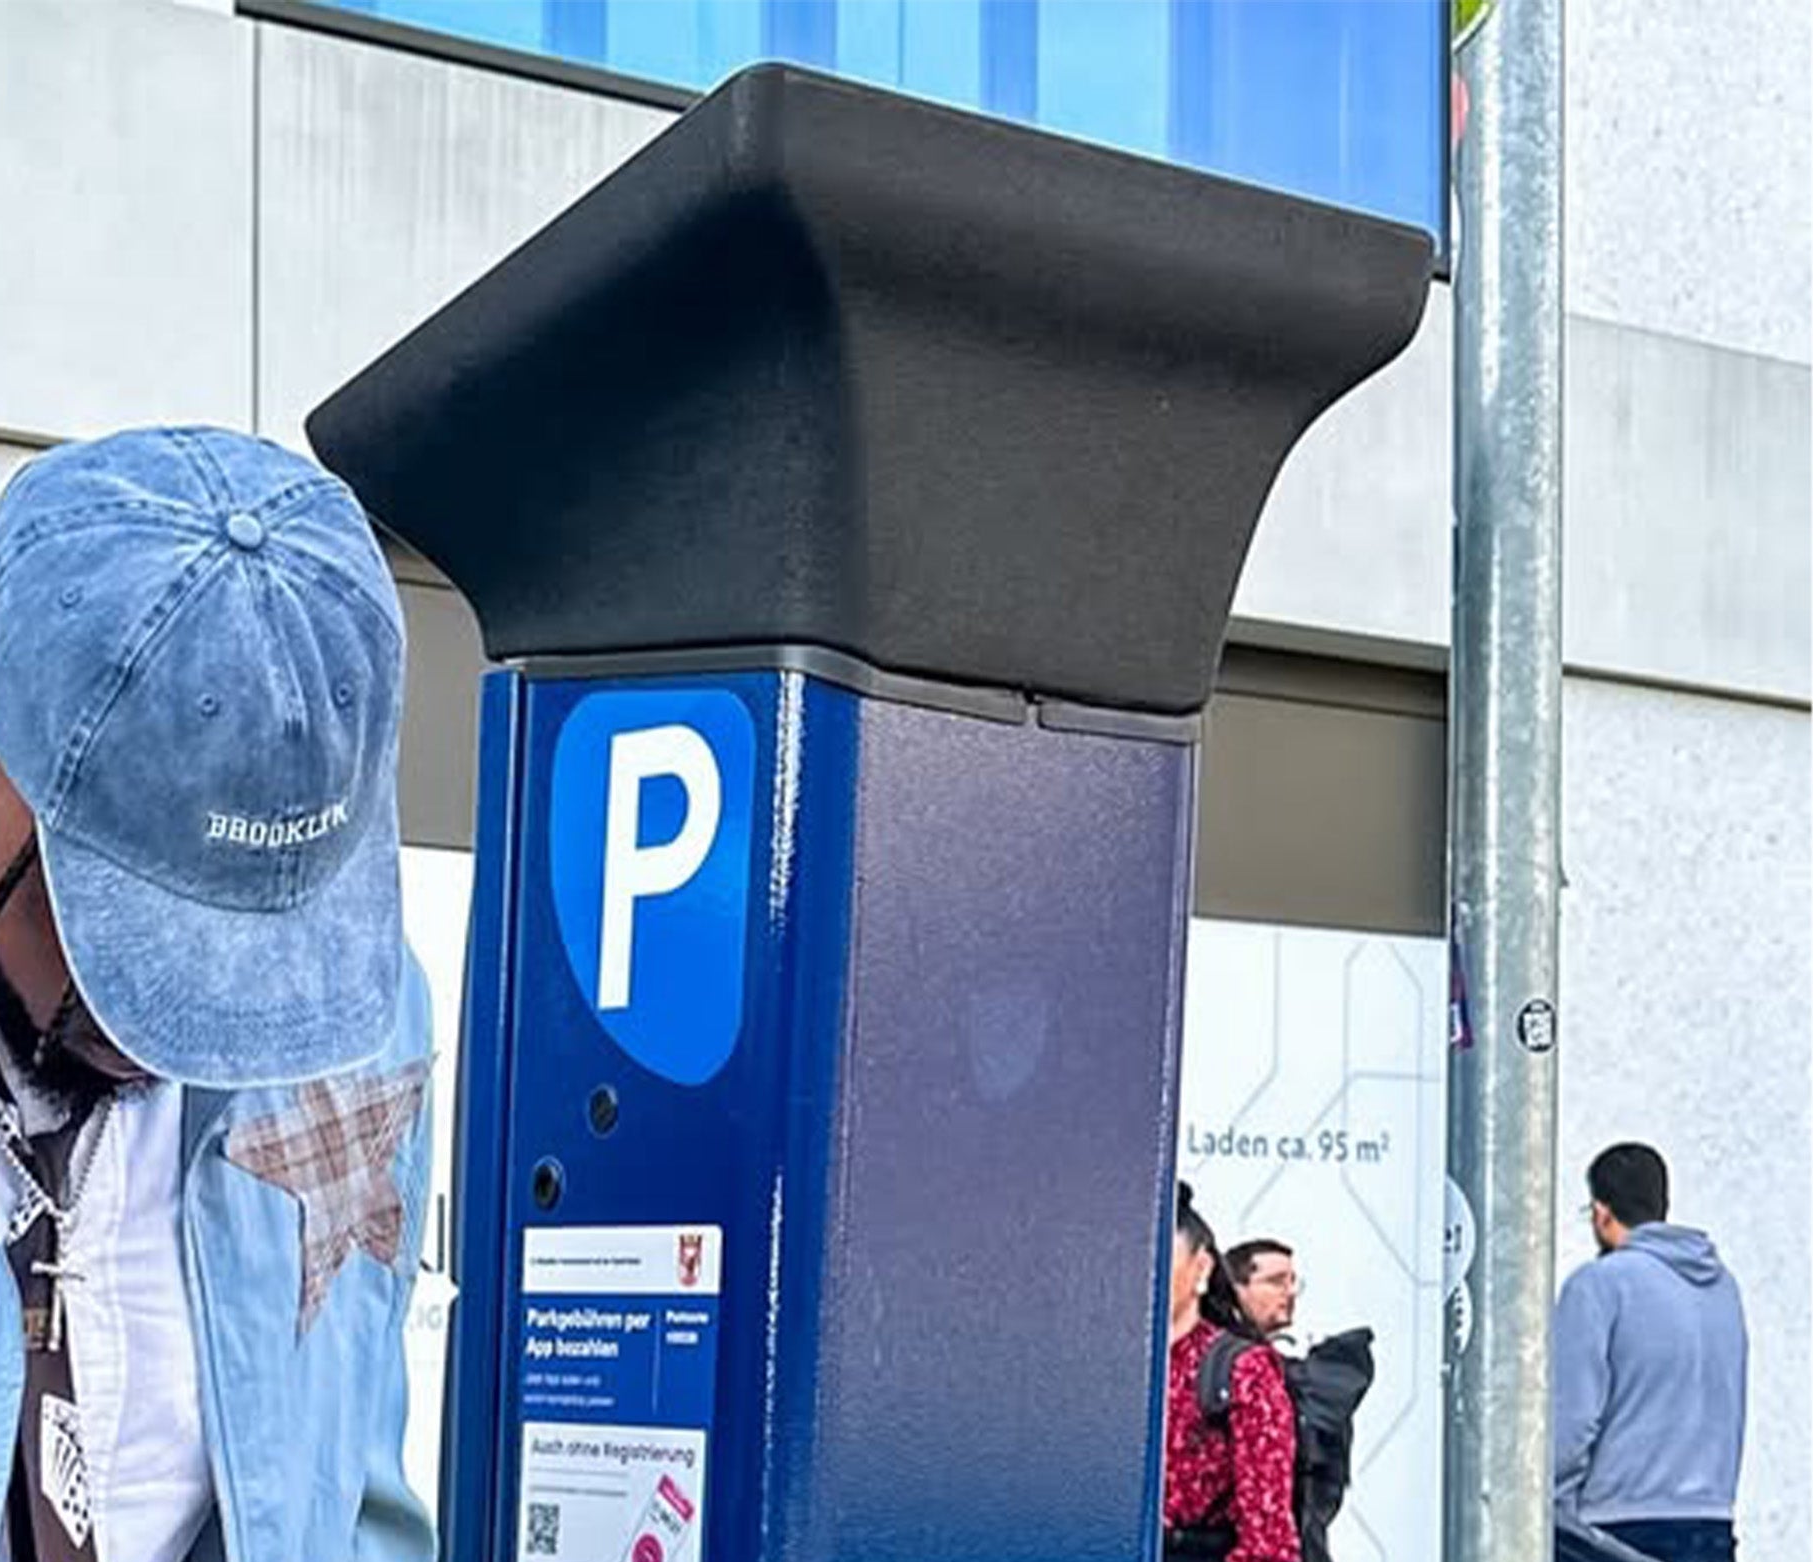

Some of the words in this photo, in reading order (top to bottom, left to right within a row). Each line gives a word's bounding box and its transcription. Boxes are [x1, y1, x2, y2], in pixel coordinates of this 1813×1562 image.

[597, 724, 722, 1011] P
[1188, 1123, 1269, 1157] Laden
[1276, 1136, 1313, 1160] ca.
[1318, 1129, 1348, 1162] 95
